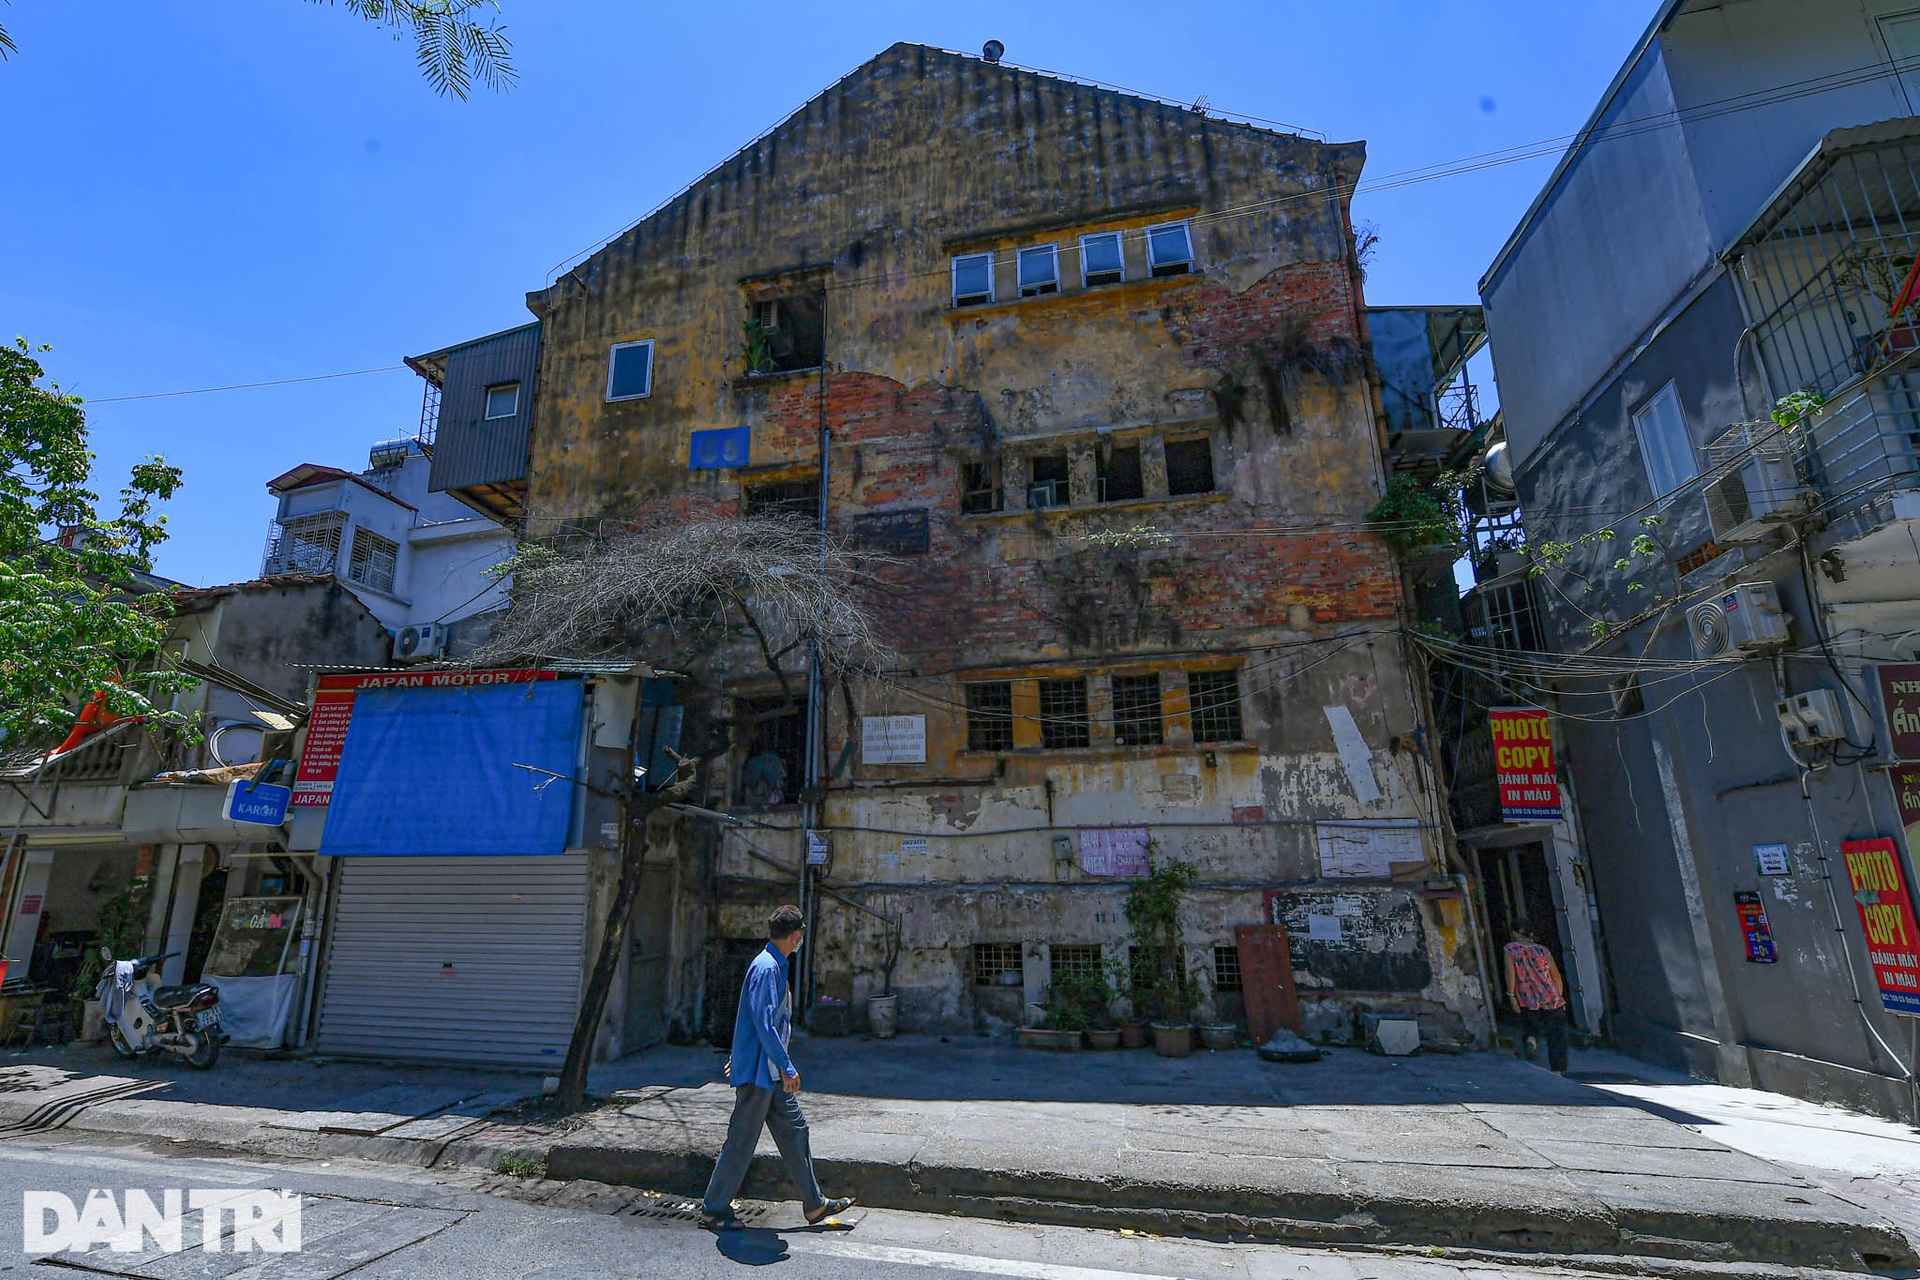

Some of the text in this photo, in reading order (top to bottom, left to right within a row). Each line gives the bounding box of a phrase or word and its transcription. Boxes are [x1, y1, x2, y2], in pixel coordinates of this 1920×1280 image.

[357, 673, 509, 688] JAPAN MOTOR
[1893, 699, 1920, 736] Án
[1490, 718, 1551, 740] PHOTO
[1498, 746, 1550, 768] COPY
[1532, 772, 1557, 785] MÁY
[294, 794, 330, 804] JAPAN
[1507, 787, 1551, 801] IN MÀU
[1903, 785, 1920, 810] Án
[238, 803, 278, 817] KAROFI
[1846, 850, 1899, 891] PHOTO
[1864, 904, 1908, 945] COPY
[1871, 949, 1919, 968] ĐÁNH MÁY
[1883, 970, 1918, 988] IN MÀU
